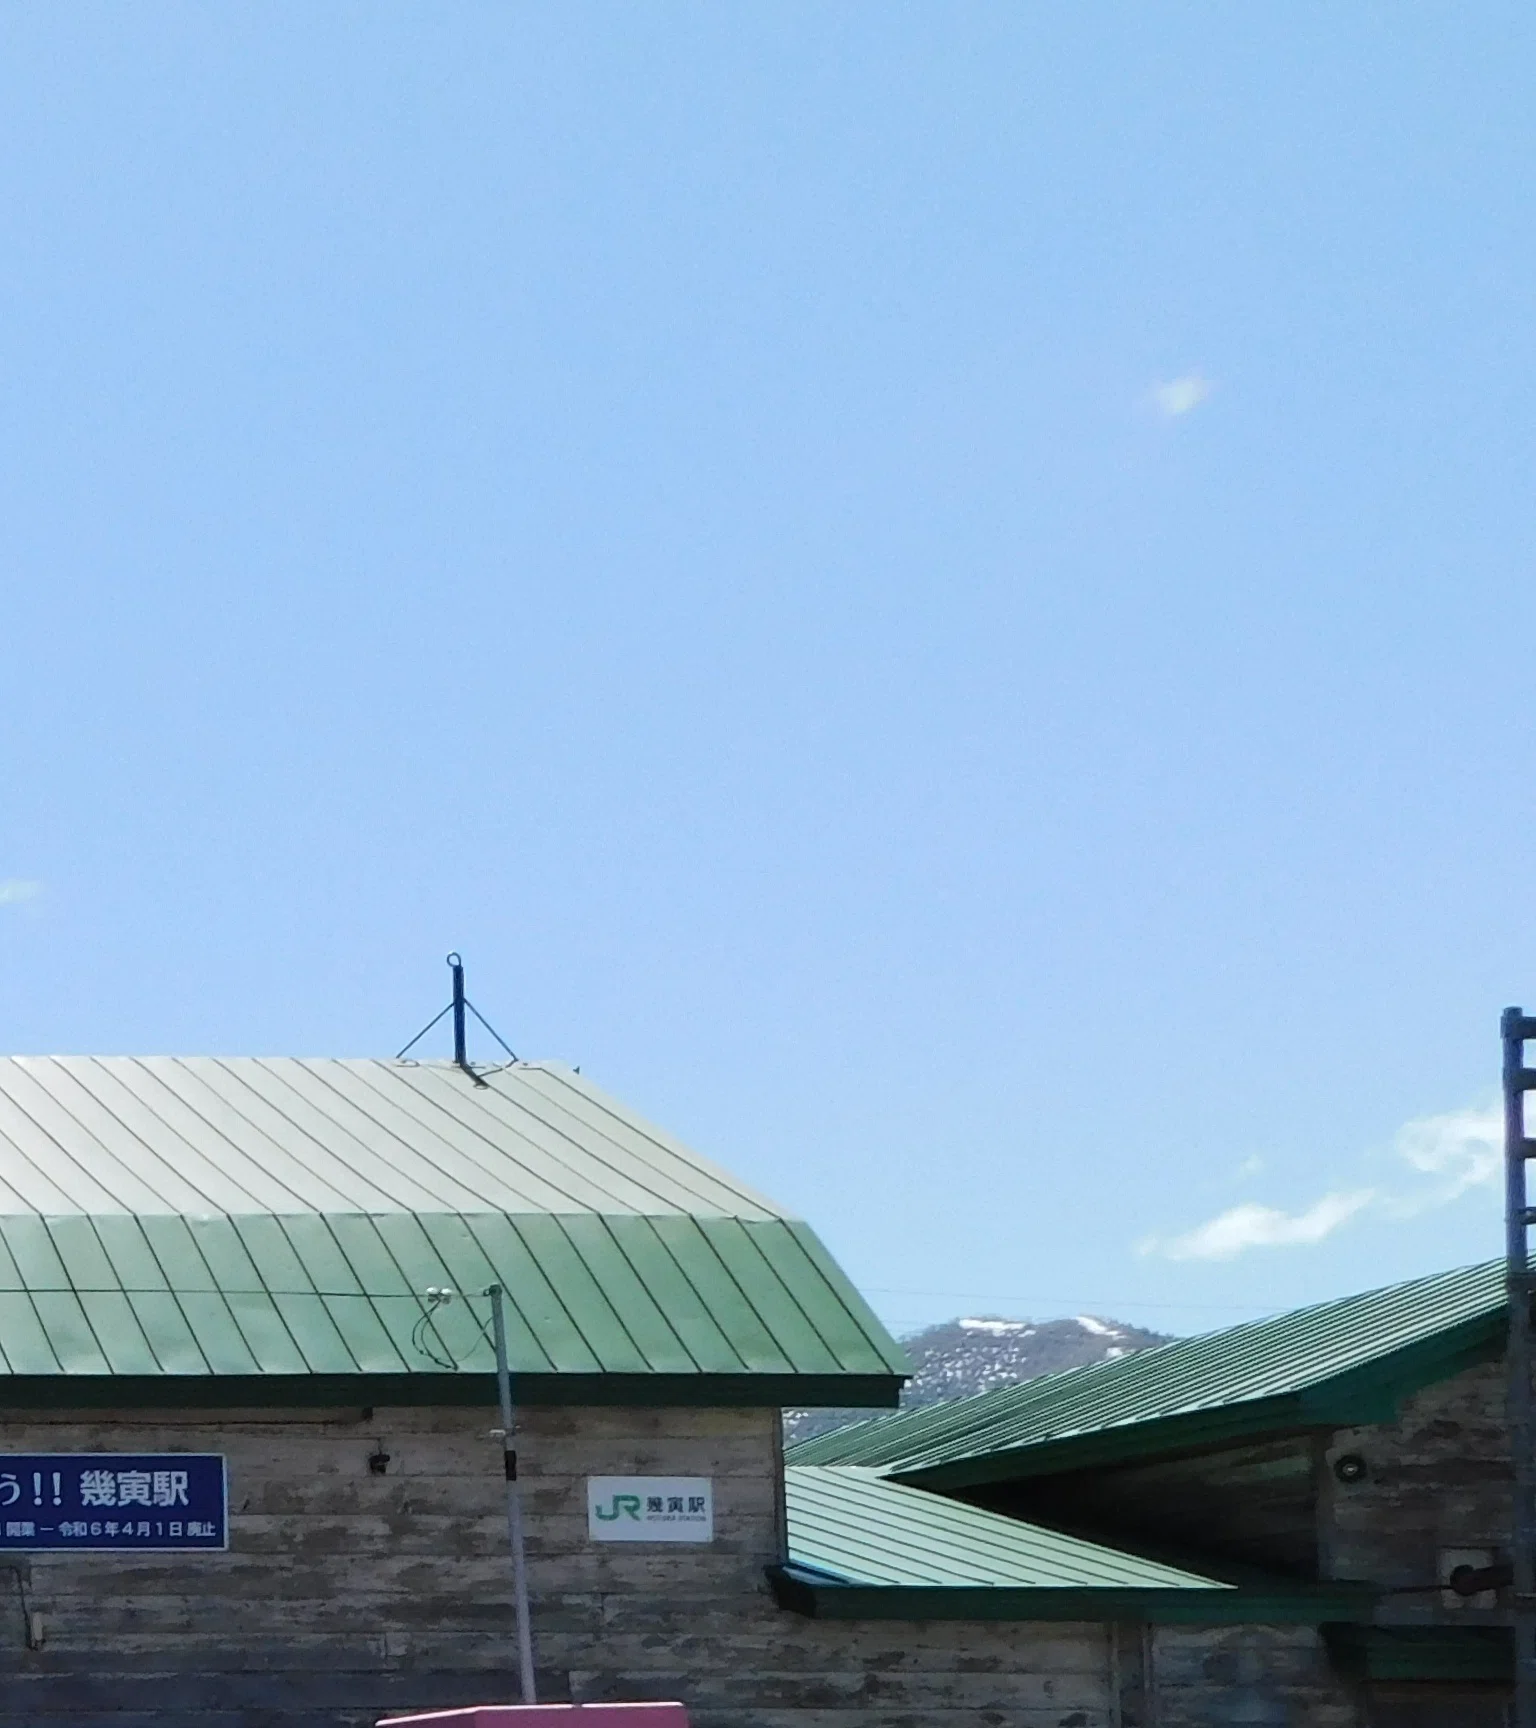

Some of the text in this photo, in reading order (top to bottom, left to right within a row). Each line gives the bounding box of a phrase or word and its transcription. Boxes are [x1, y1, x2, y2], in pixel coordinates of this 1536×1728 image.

[79, 1470, 190, 1508] 幾寅駅
[595, 1494, 641, 1521] JR
